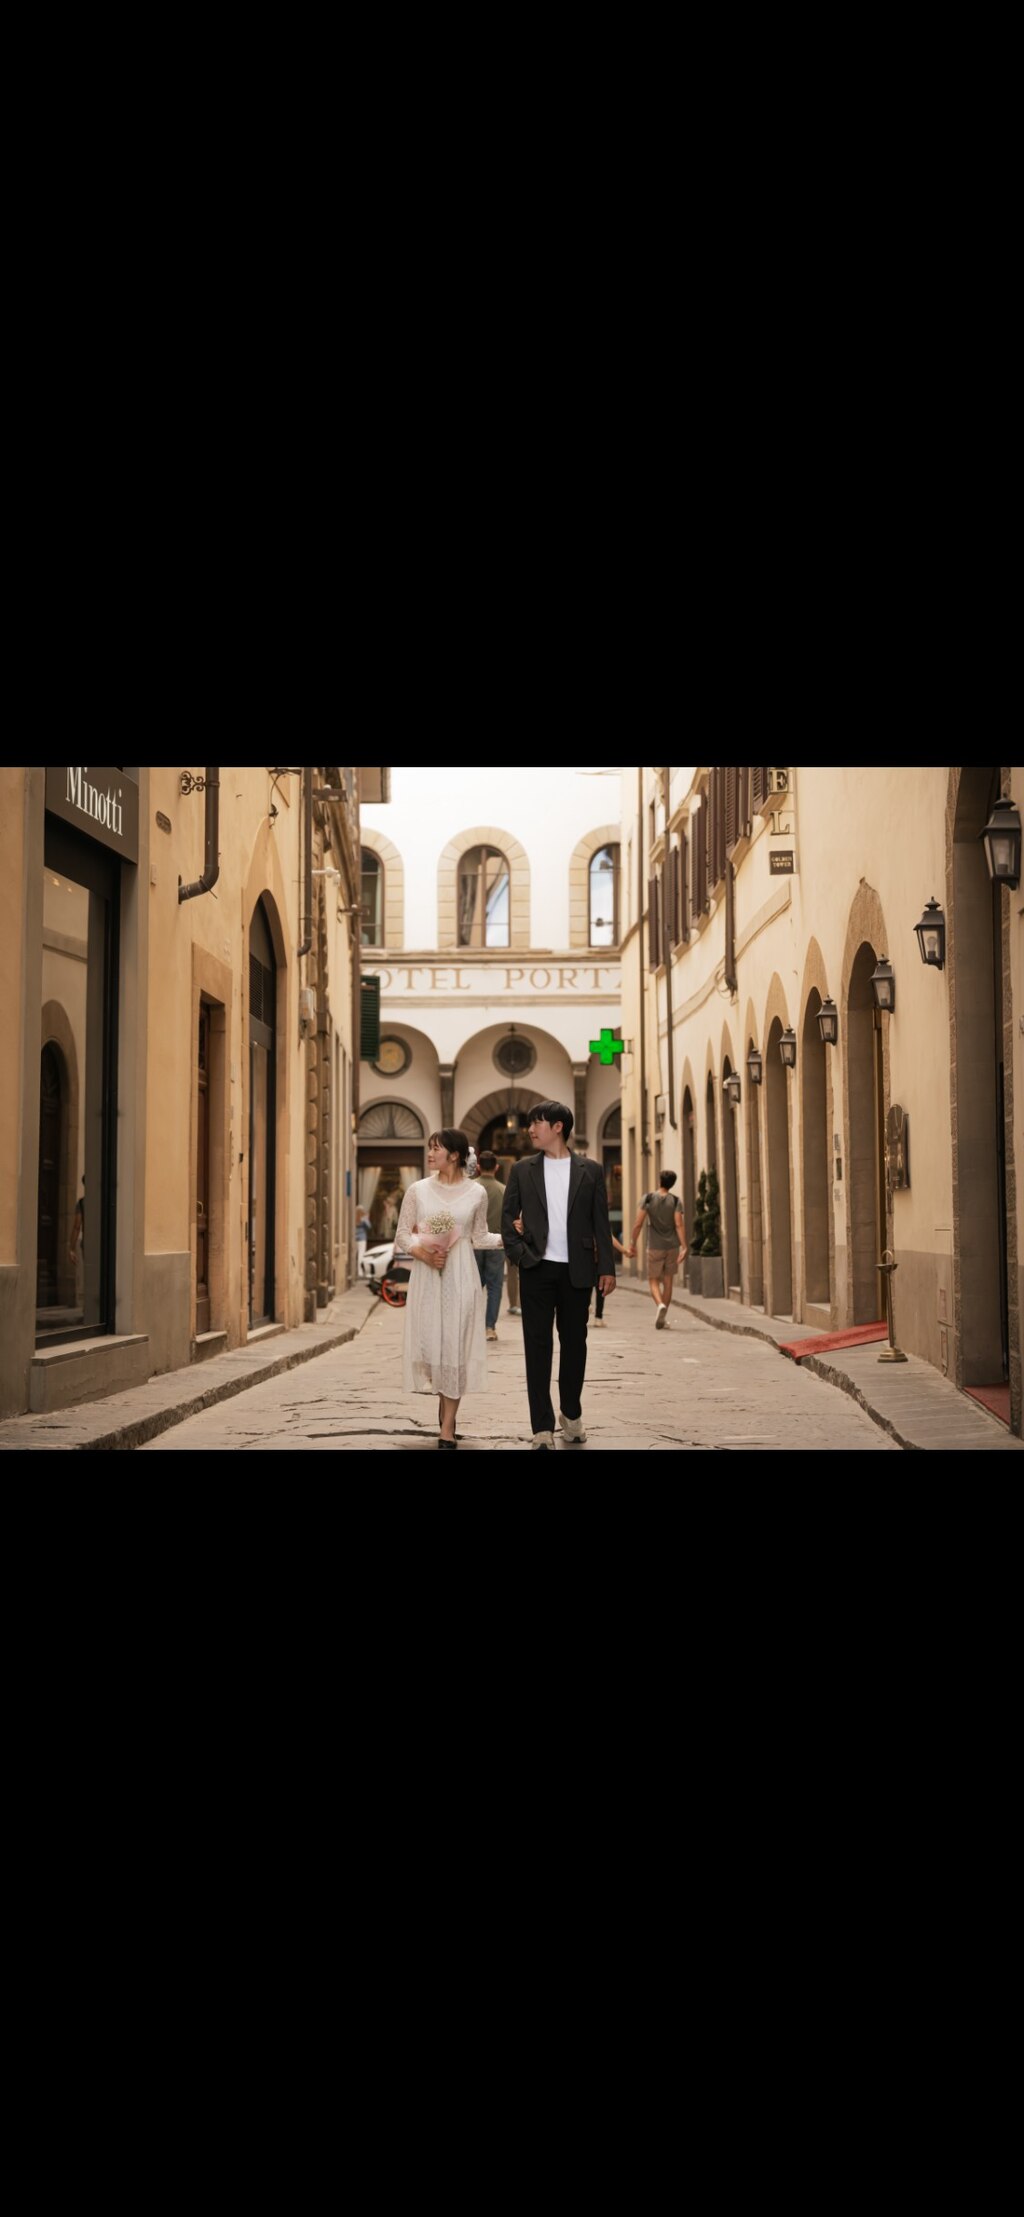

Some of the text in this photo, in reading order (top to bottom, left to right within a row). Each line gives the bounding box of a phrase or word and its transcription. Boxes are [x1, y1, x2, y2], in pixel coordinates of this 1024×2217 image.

[65, 767, 123, 836] Minotti
[361, 967, 621, 990] OTEL PORT
